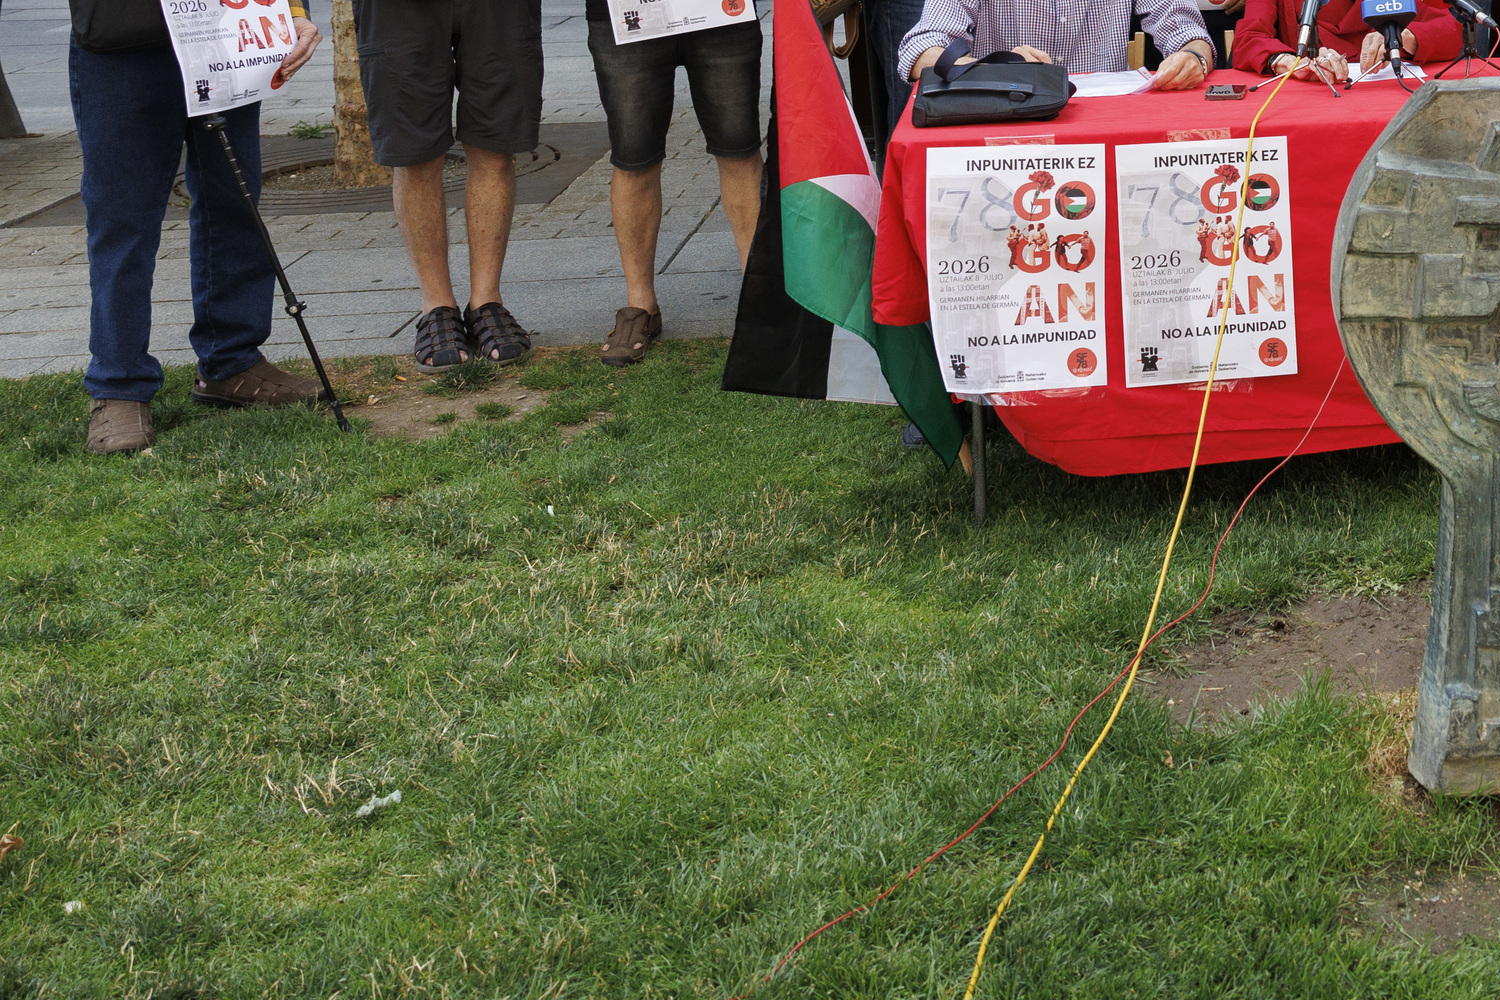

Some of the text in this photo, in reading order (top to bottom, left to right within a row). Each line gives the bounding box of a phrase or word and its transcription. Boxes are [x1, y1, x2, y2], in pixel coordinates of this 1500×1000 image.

[1375, 0, 1403, 13] etb
[208, 59, 245, 72] NO A LA
[966, 157, 1095, 171] INPUNITATERIK EZ
[1154, 150, 1278, 168] INPUNITATERIK EZ
[938, 256, 989, 275] 2026
[1131, 250, 1181, 270] 2026
[939, 275, 973, 283] UZTAILAK
[983, 273, 1003, 281] JULIO
[939, 294, 1009, 304] GERMANEN HILARRIAN
[991, 300, 1019, 309] GERMÁN
[1013, 282, 1095, 326] AN
[968, 330, 1096, 347] NO A LA IMPUNIDAD
[1161, 328, 1183, 339] NO
[1184, 327, 1194, 337] A
[1196, 326, 1211, 336] LA
